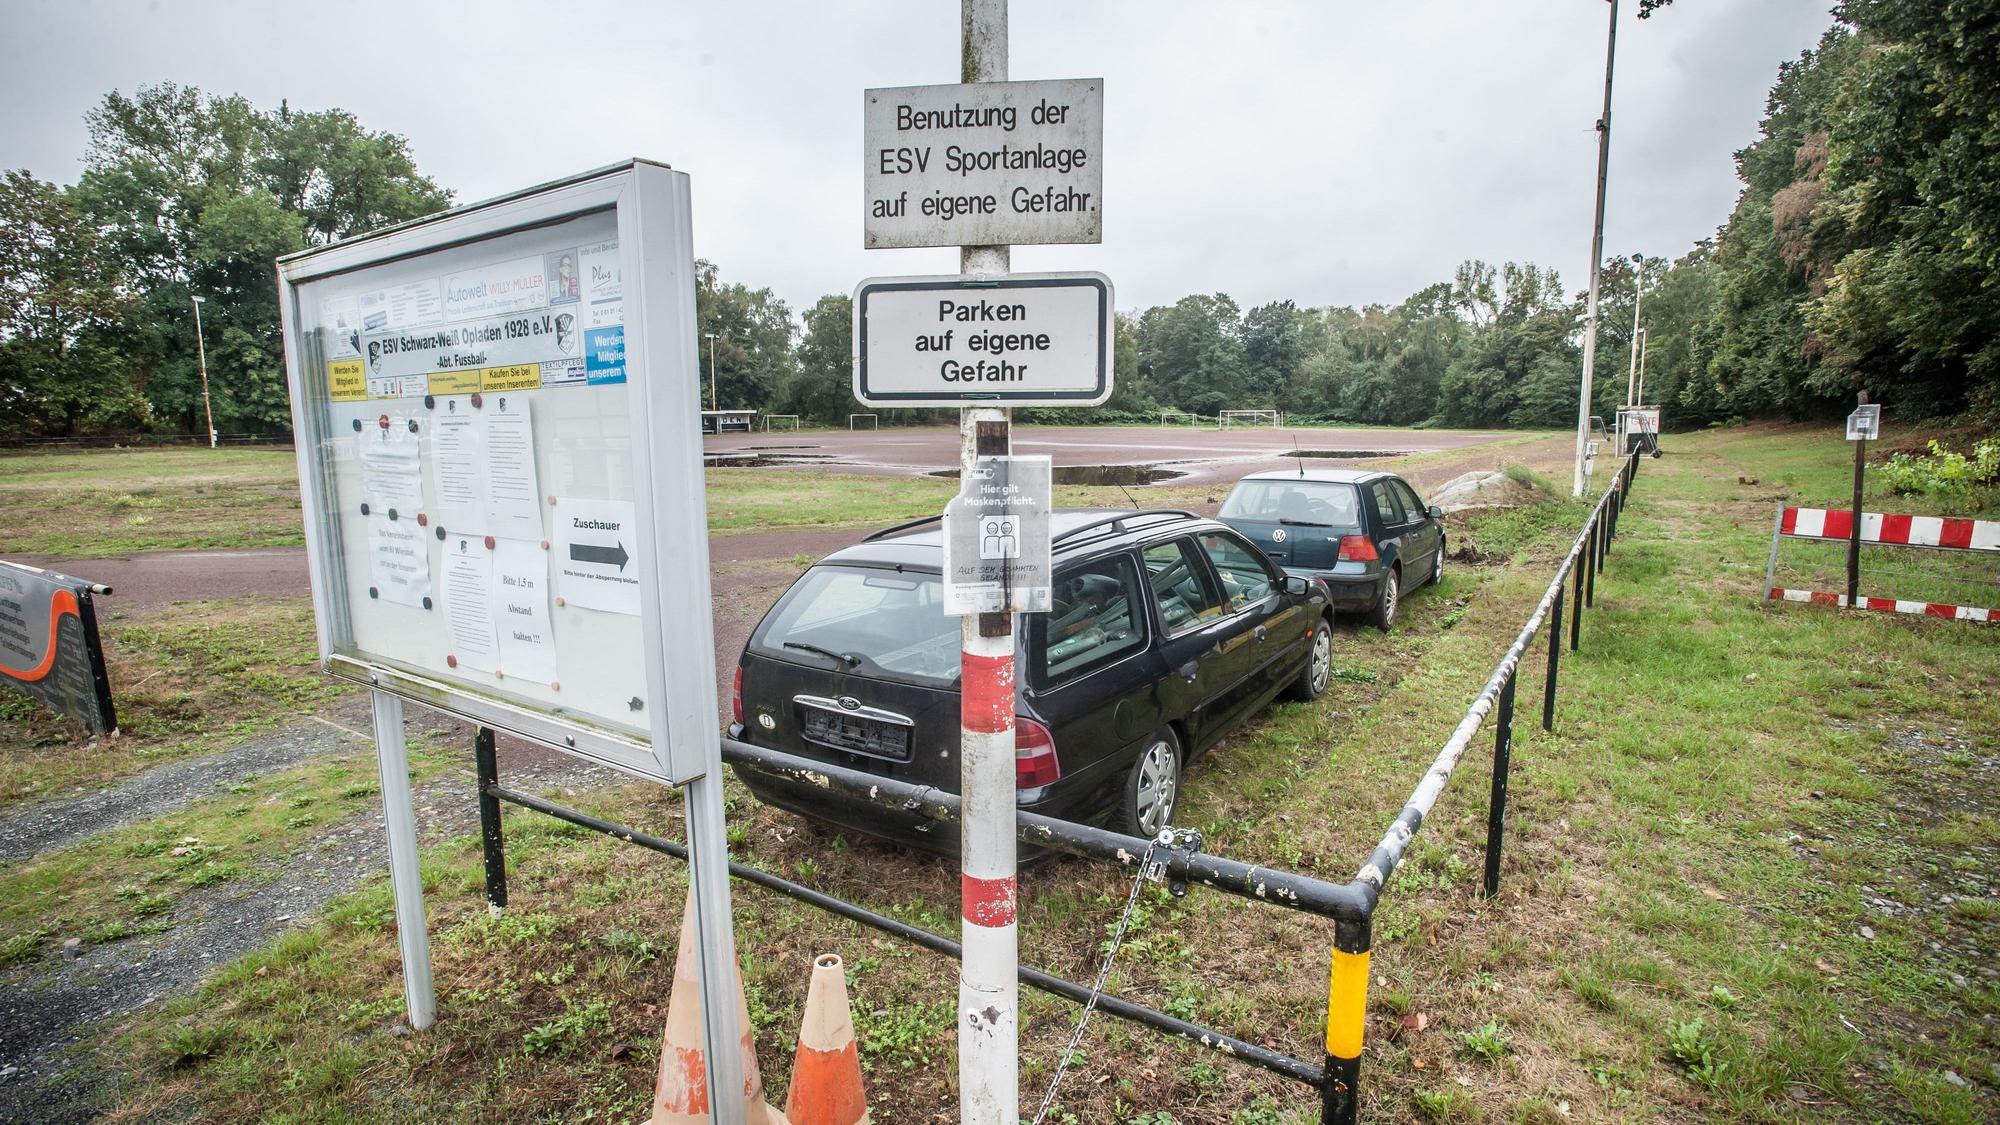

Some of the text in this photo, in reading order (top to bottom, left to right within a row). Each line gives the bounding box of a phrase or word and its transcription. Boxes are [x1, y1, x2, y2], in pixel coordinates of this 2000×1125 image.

[897, 98, 1069, 132] Benutzung der
[880, 143, 1087, 176] ESV Sportanlage
[872, 186, 1096, 221] auf eigene Gefahr.
[592, 264, 611, 284] Plus
[447, 281, 488, 303] Autowelt
[489, 279, 511, 296] WILLY
[513, 274, 544, 292] MÜLLER
[939, 300, 1026, 322] Parken
[382, 337, 399, 355] ESV
[400, 328, 460, 352] Schwarz-Weiß
[462, 325, 502, 348] Opladen
[504, 318, 530, 340] 1928
[532, 315, 553, 336] e.V.
[594, 335, 624, 347] Werden
[915, 330, 1050, 355] auf eigene
[597, 350, 625, 364] Mitglie
[542, 359, 584, 369] TEXTILPFLEGE
[489, 366, 531, 379] Kaufen Sie bei
[588, 367, 622, 379] unserem
[941, 360, 1027, 382] Gefahr
[335, 377, 359, 387] Mitglied in
[483, 382, 506, 391] unseren
[506, 379, 539, 388] Inserenten!
[980, 484, 1019, 495] Hier gilt
[964, 495, 1036, 507] Maskenpflicht.
[573, 517, 620, 531] Zuschauer
[957, 566, 976, 575] AUF
[503, 575, 517, 586] Bitte
[528, 580, 534, 588] m
[595, 573, 622, 583] Absperrung
[508, 603, 532, 616] Abstand
[513, 630, 533, 642] halten
